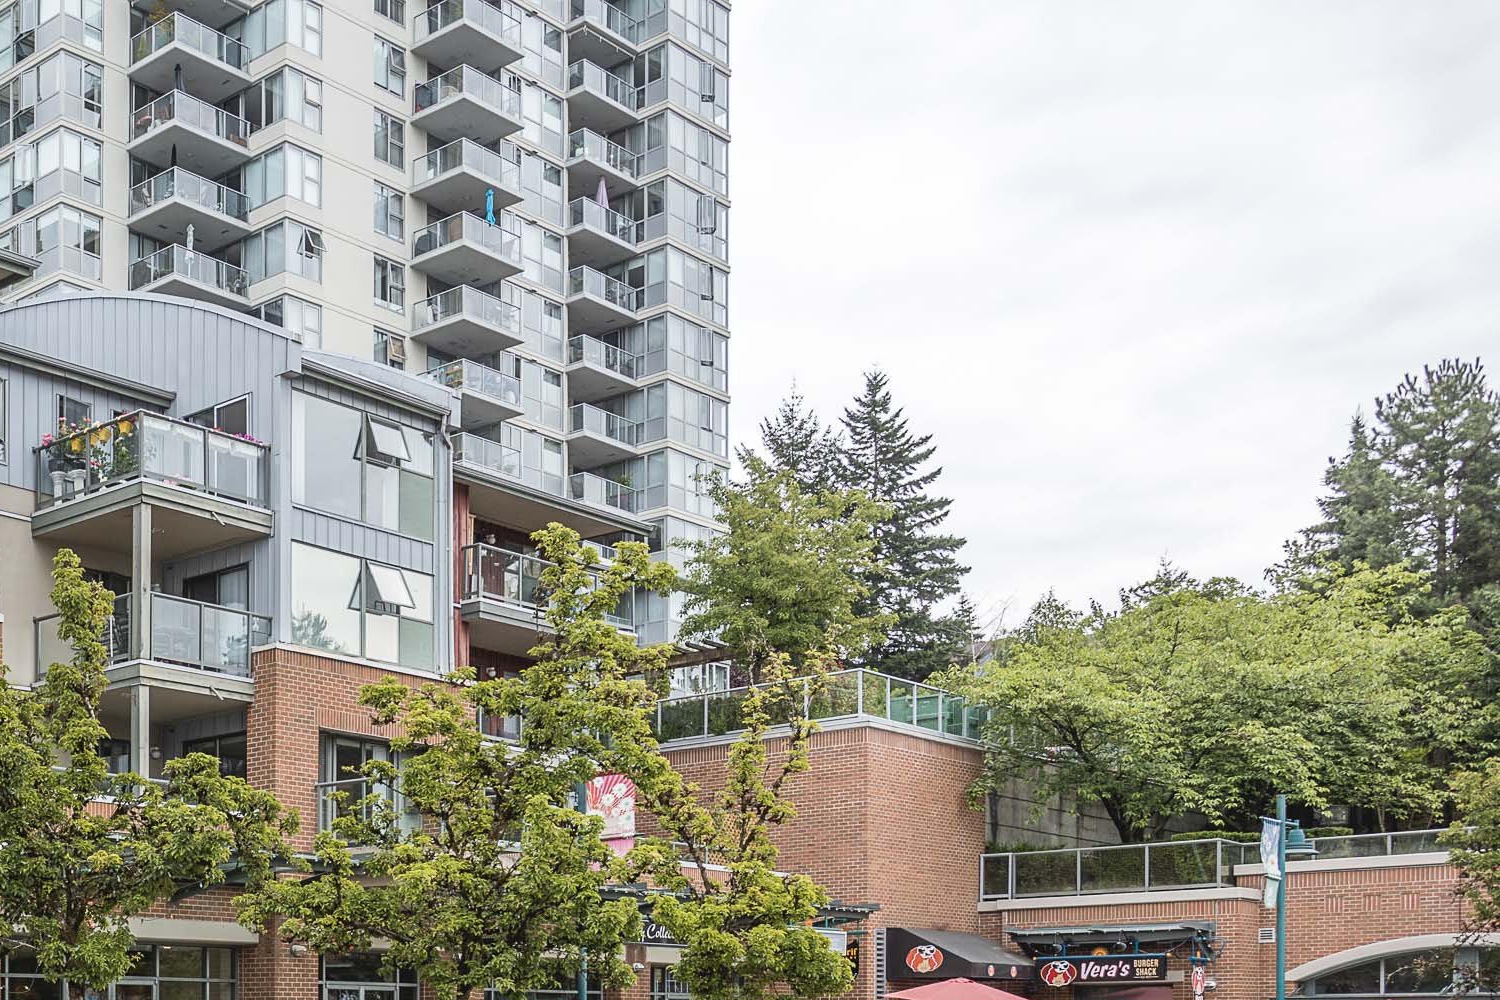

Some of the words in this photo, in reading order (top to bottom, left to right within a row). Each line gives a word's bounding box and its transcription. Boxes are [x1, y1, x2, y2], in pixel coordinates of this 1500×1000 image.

[1080, 960, 1130, 981] Vera's
[1135, 967, 1157, 976] SHACK
[1133, 958, 1159, 968] BURGER
